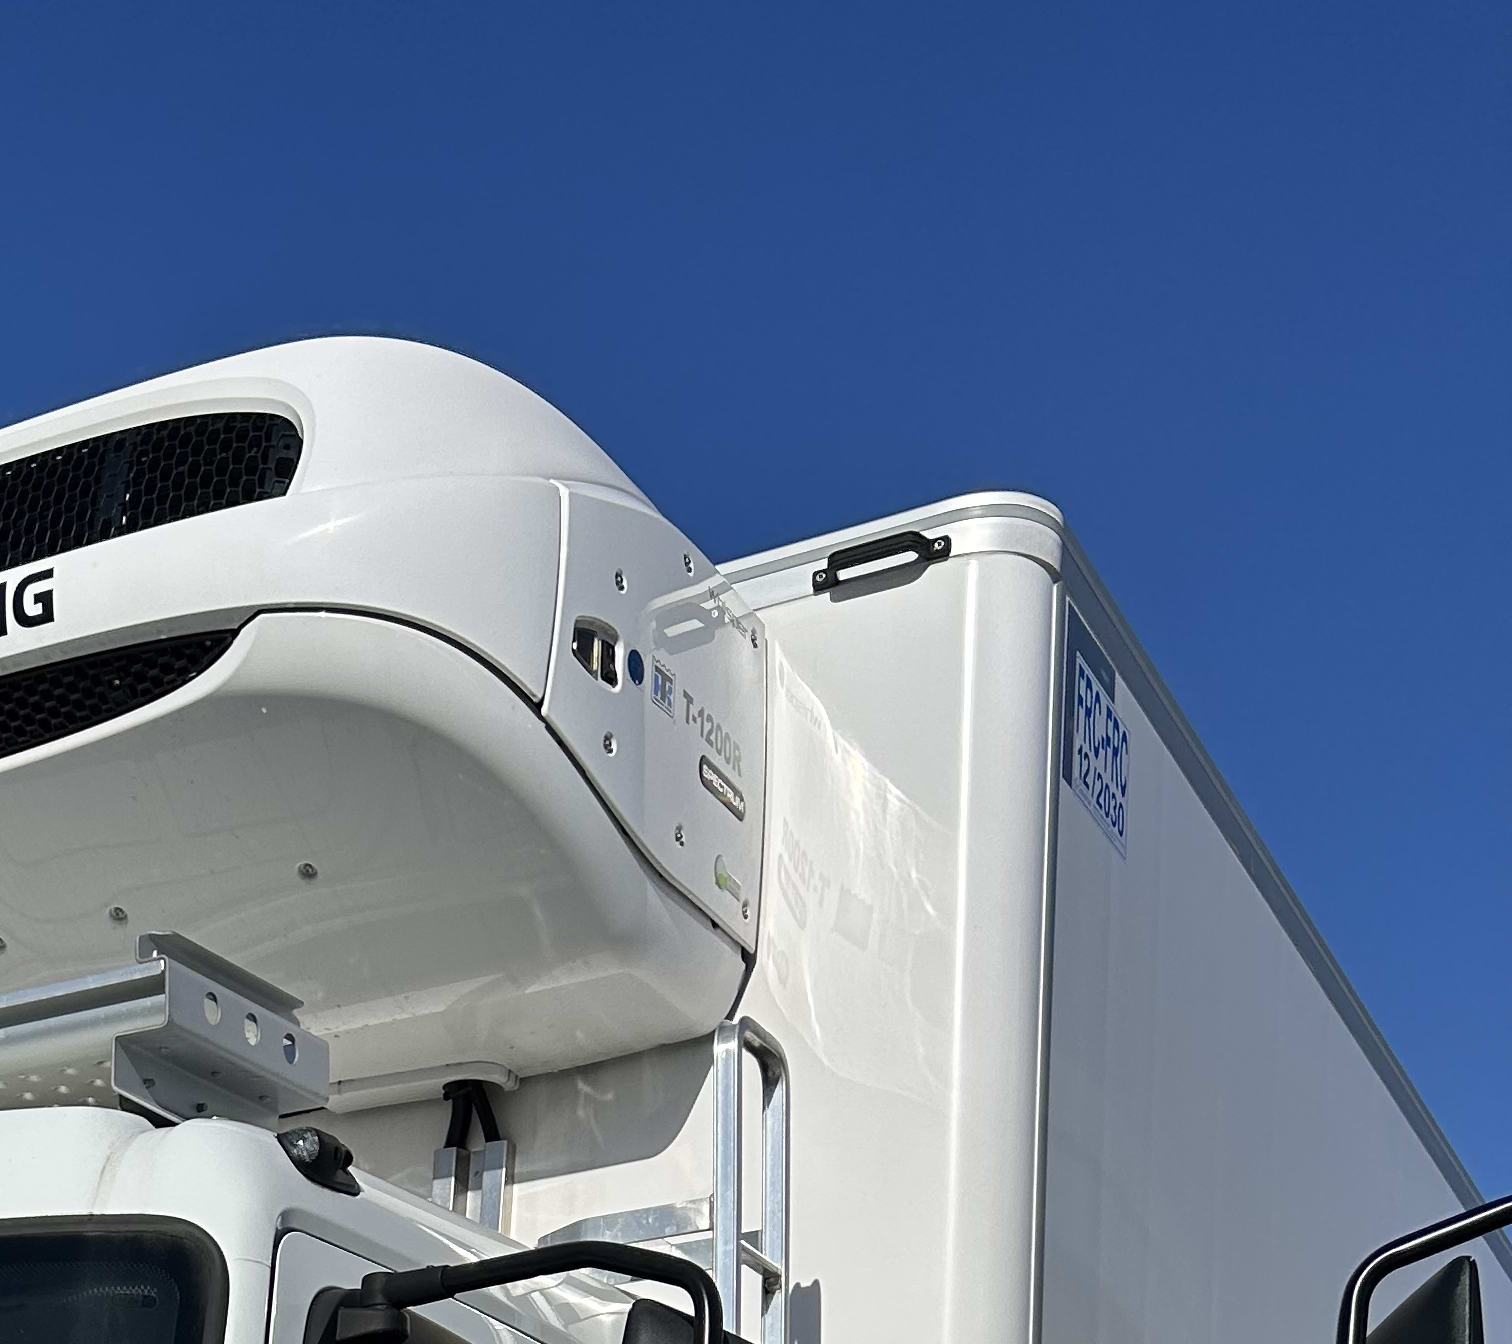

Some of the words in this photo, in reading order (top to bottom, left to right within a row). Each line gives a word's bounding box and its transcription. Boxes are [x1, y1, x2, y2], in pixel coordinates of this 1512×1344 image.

[682, 688, 743, 777] T-1200R
[1077, 662, 1128, 798] FRC-FRC
[1078, 745, 1125, 838] 12/2030
